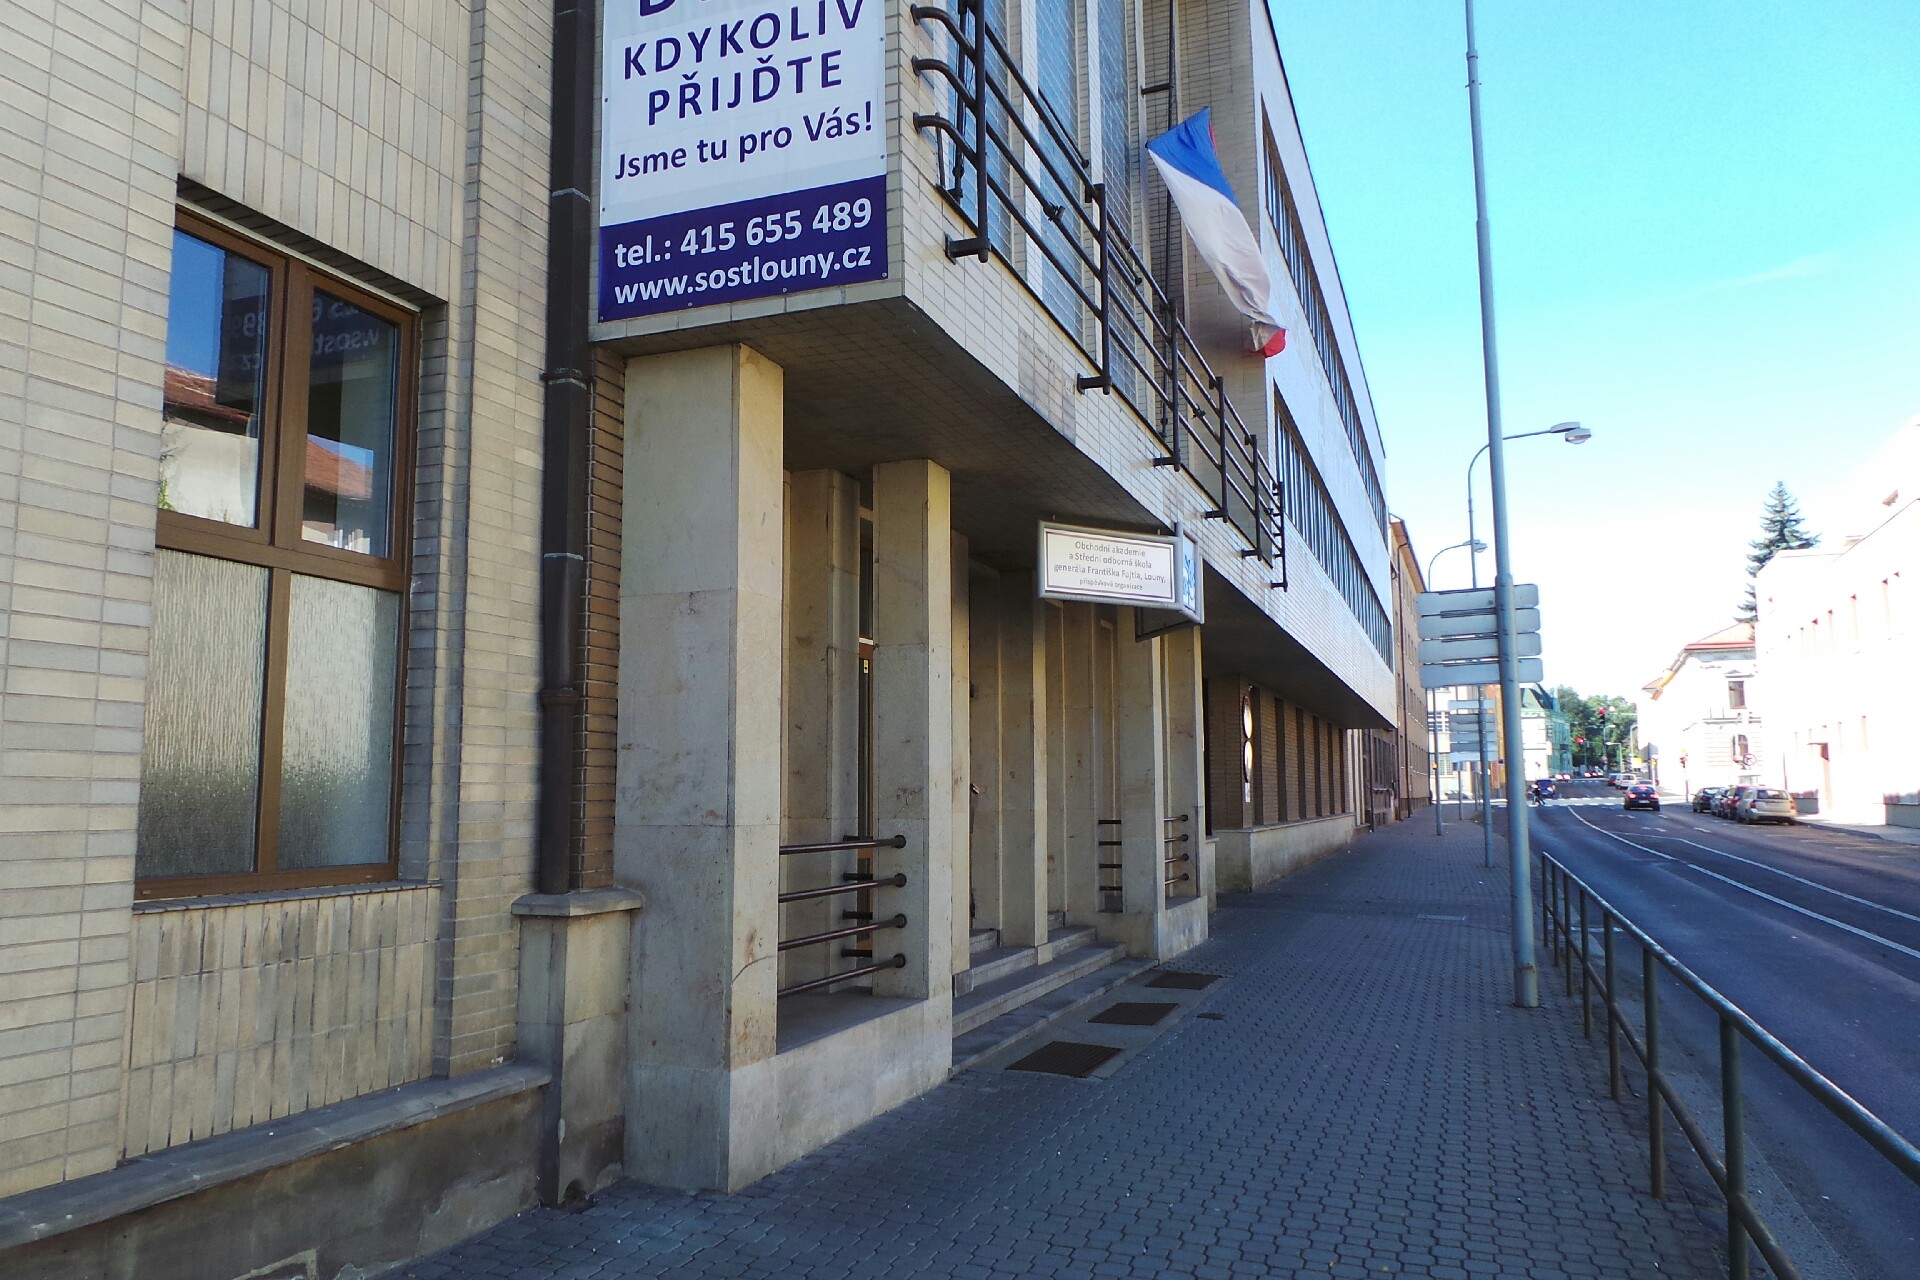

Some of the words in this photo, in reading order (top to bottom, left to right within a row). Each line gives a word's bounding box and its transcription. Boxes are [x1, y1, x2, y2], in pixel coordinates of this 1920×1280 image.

[624, 0, 865, 80] KDYKOLIV
[648, 50, 842, 126] PŘIJĎTE
[614, 147, 687, 180] Jsme
[697, 138, 727, 162] tu
[739, 126, 792, 163] pro
[803, 100, 873, 143] Vás!
[614, 235, 672, 268] tel.:
[680, 222, 736, 256] 415
[745, 209, 802, 246] 655
[812, 198, 872, 234] 489
[614, 245, 872, 304] www.sostlouny.cz
[1054, 563, 1086, 574] generála
[1087, 565, 1120, 577] Františka
[1075, 541, 1111, 554] Obchodní
[1111, 547, 1146, 557] akademie
[1075, 552, 1102, 563] Střední
[1102, 556, 1133, 567] odborná
[1134, 559, 1152, 569] škola
